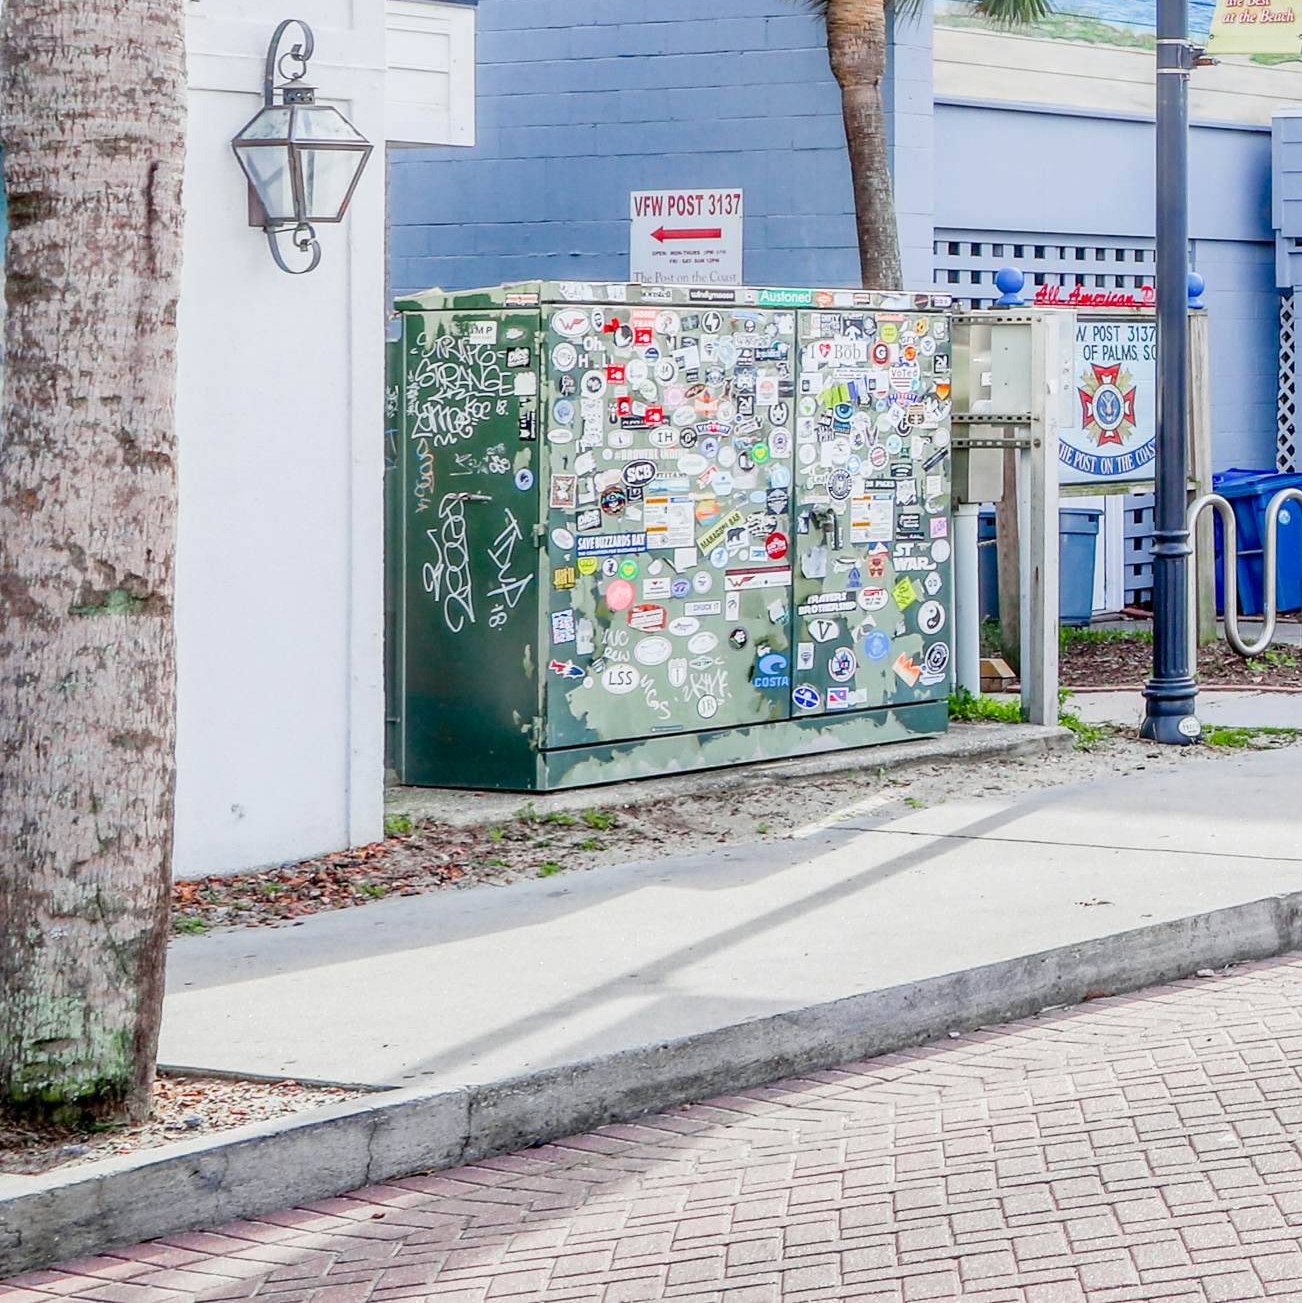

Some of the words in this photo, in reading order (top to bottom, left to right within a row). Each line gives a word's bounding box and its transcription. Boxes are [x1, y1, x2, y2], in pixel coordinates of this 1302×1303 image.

[1223, 13, 1235, 23] at
[1239, 9, 1256, 23] the
[1259, 8, 1295, 23] Beach
[634, 196, 663, 216] VFW
[668, 195, 704, 216] POST
[708, 193, 741, 215] 3137
[634, 272, 652, 283] The
[655, 271, 674, 283] Post
[677, 275, 687, 283] on
[691, 271, 708, 283] the
[709, 270, 736, 283] Coast
[1035, 283, 1060, 302] All
[1069, 283, 1135, 304] American
[1093, 325, 1120, 343] POST
[1128, 325, 1156, 343] 3137
[1083, 345, 1098, 361] OF
[1074, 451, 1095, 473] POST
[1101, 457, 1114, 474] ON
[1117, 453, 1135, 472] THE
[1136, 443, 1156, 466] COAS
[626, 464, 652, 483] SCB
[578, 537, 595, 551] SAVE
[595, 534, 631, 550] BUZZARDS
[632, 533, 646, 547] BAY
[609, 671, 633, 686] LSS
[755, 677, 789, 687] COSTA
